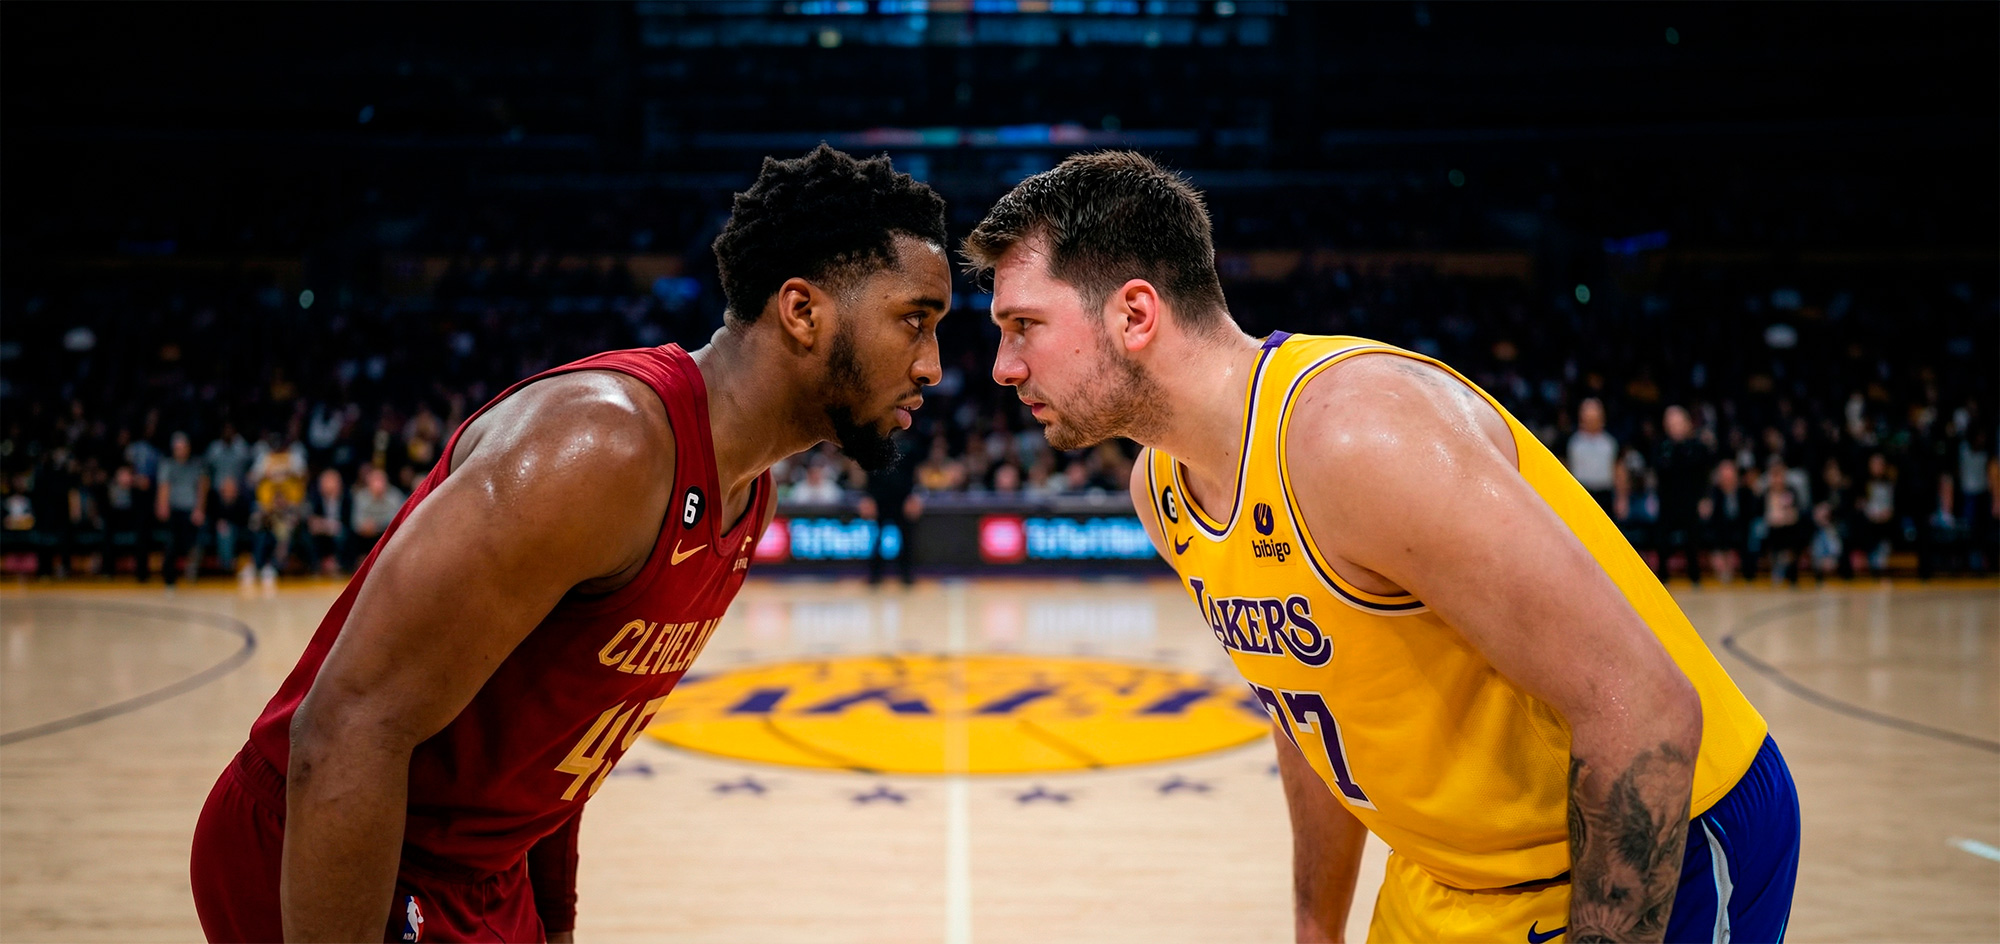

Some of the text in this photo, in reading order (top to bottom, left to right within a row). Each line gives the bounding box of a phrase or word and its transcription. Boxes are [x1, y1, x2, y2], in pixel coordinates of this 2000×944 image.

[684, 492, 699, 524] 6
[1166, 491, 1178, 519] 6
[1251, 538, 1291, 562] bibigo
